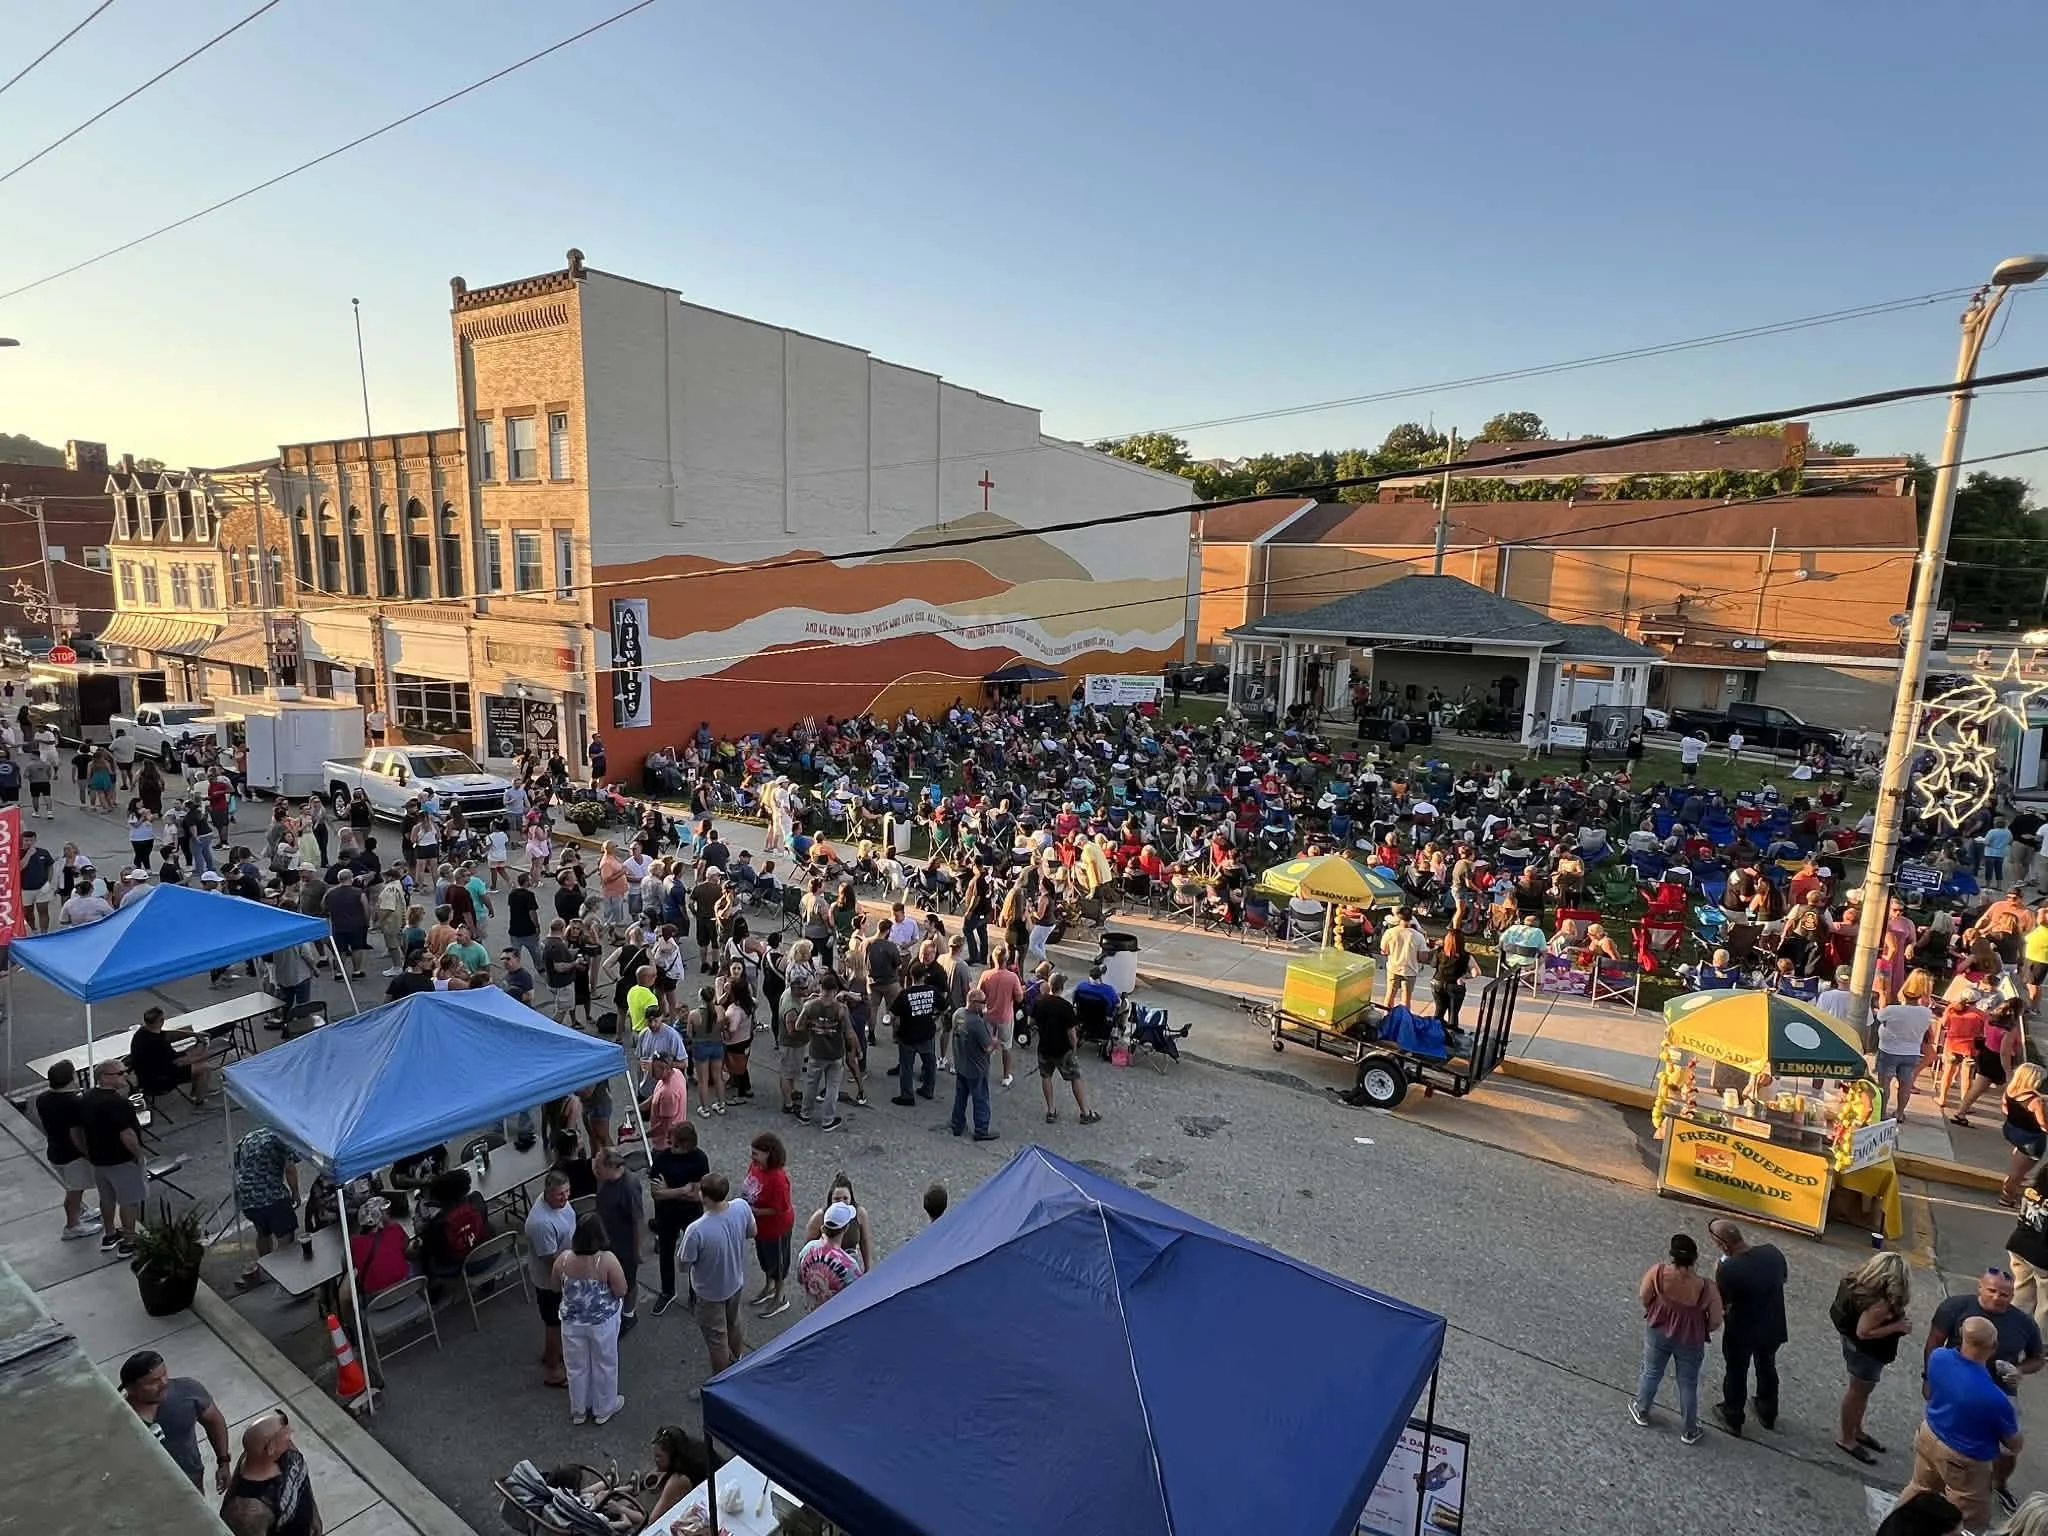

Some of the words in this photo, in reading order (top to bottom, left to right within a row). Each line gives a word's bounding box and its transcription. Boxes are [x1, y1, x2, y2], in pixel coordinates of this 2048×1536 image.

[805, 622, 818, 633] AND
[829, 625, 845, 637] KNOW
[50, 652, 74, 663] STOP
[1310, 889, 1362, 903] LEMONADE
[1779, 1062, 1852, 1076] LEMONADE
[1677, 1131, 1728, 1145] FRESH
[1732, 1140, 1818, 1186] SQUEEZED
[1694, 1167, 1792, 1201] LEMONADE
